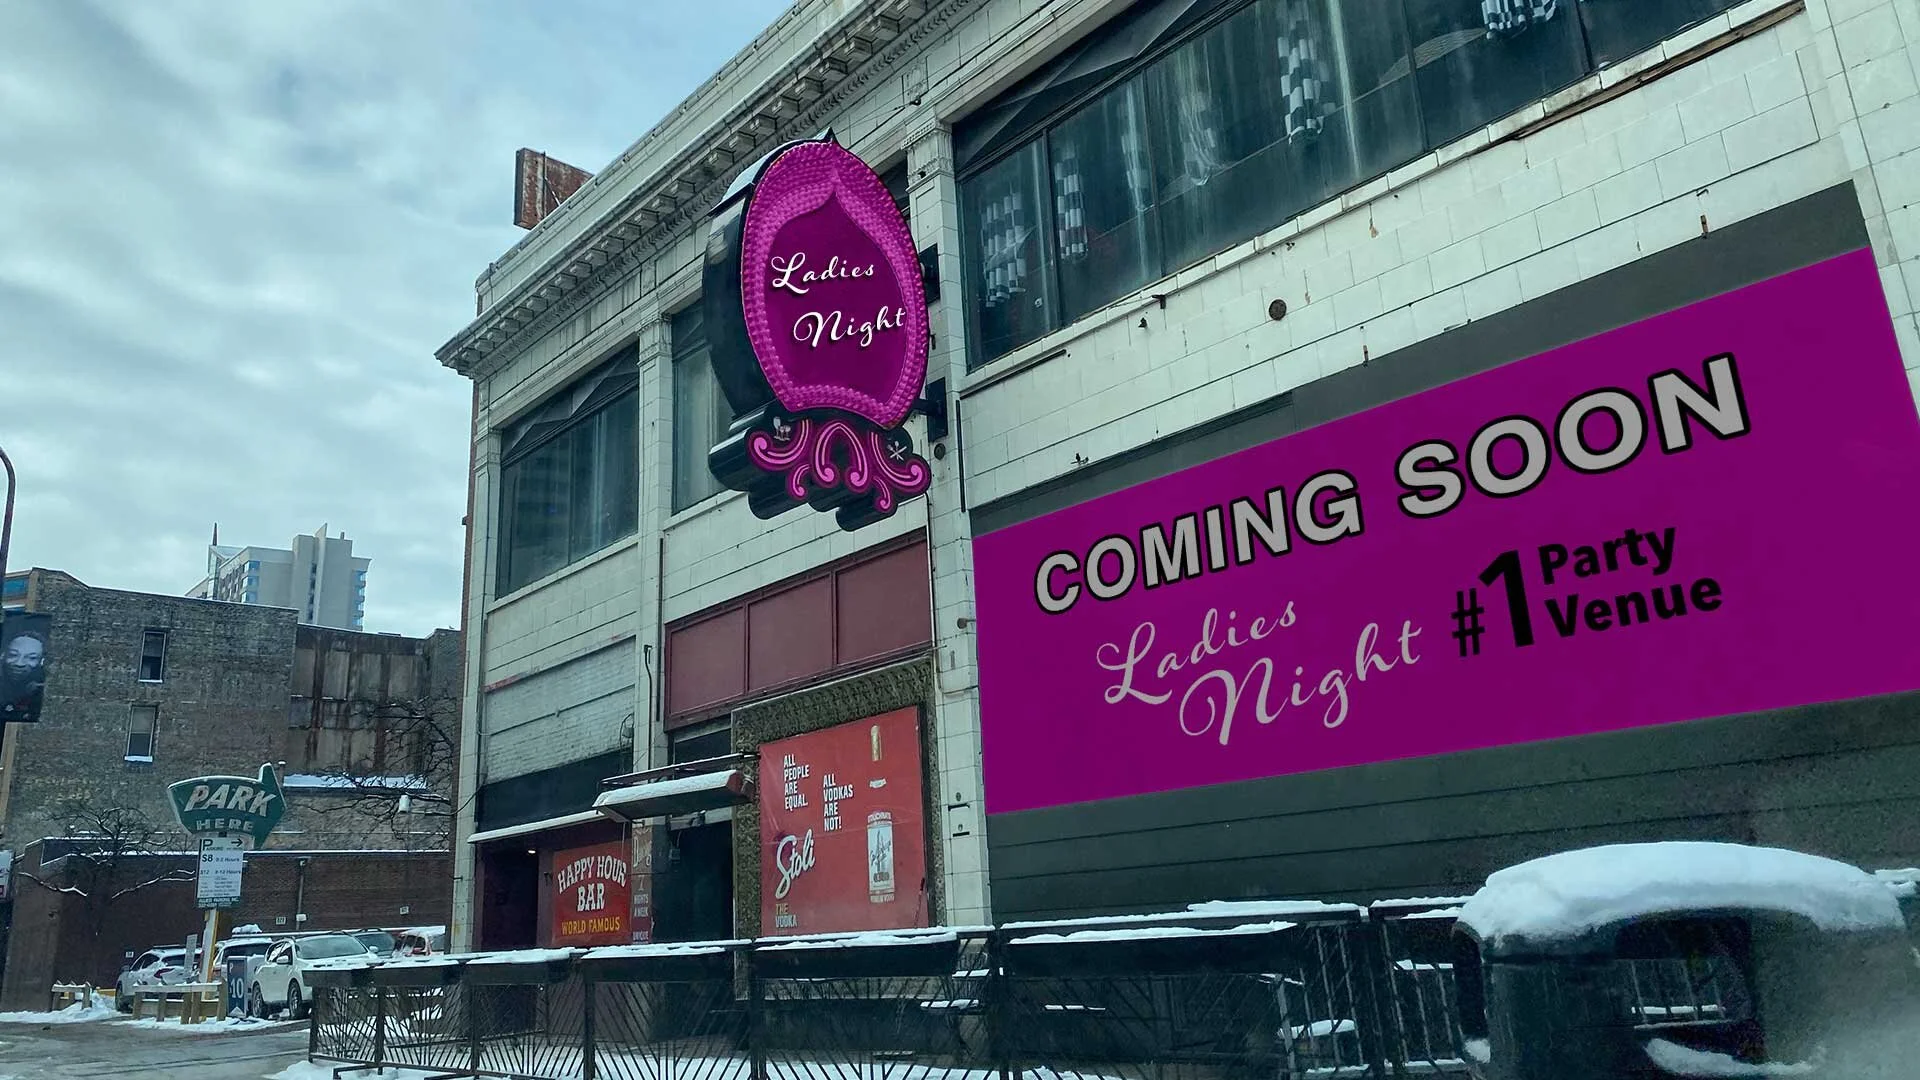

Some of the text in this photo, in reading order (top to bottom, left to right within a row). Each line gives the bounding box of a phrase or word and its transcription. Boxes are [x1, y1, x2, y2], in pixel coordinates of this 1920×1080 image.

[771, 252, 874, 294] Ladies
[793, 305, 907, 349] Night
[1034, 351, 1751, 615] COMING SOON
[1451, 525, 1678, 658] #1 Party
[1545, 576, 1724, 638] Venue
[1096, 600, 1297, 705] Ladies
[1179, 619, 1422, 746] Night
[783, 753, 796, 769] ALL
[784, 764, 810, 782] PEOPLE
[823, 773, 837, 788] ALL
[784, 780, 798, 796] ARE
[823, 784, 854, 802] VODKAS
[184, 783, 277, 817] PARK
[785, 793, 809, 812] EQUAL.
[824, 802, 838, 817] ARE
[196, 818, 254, 833] HERE
[824, 815, 842, 832] NOT!
[775, 828, 815, 899] Stoli
[557, 855, 627, 895] HAPPY HOUR
[577, 883, 606, 912] BAR
[776, 903, 789, 915] THE
[562, 916, 621, 935] WORLD FAMOUS
[775, 914, 798, 928] VODKA
